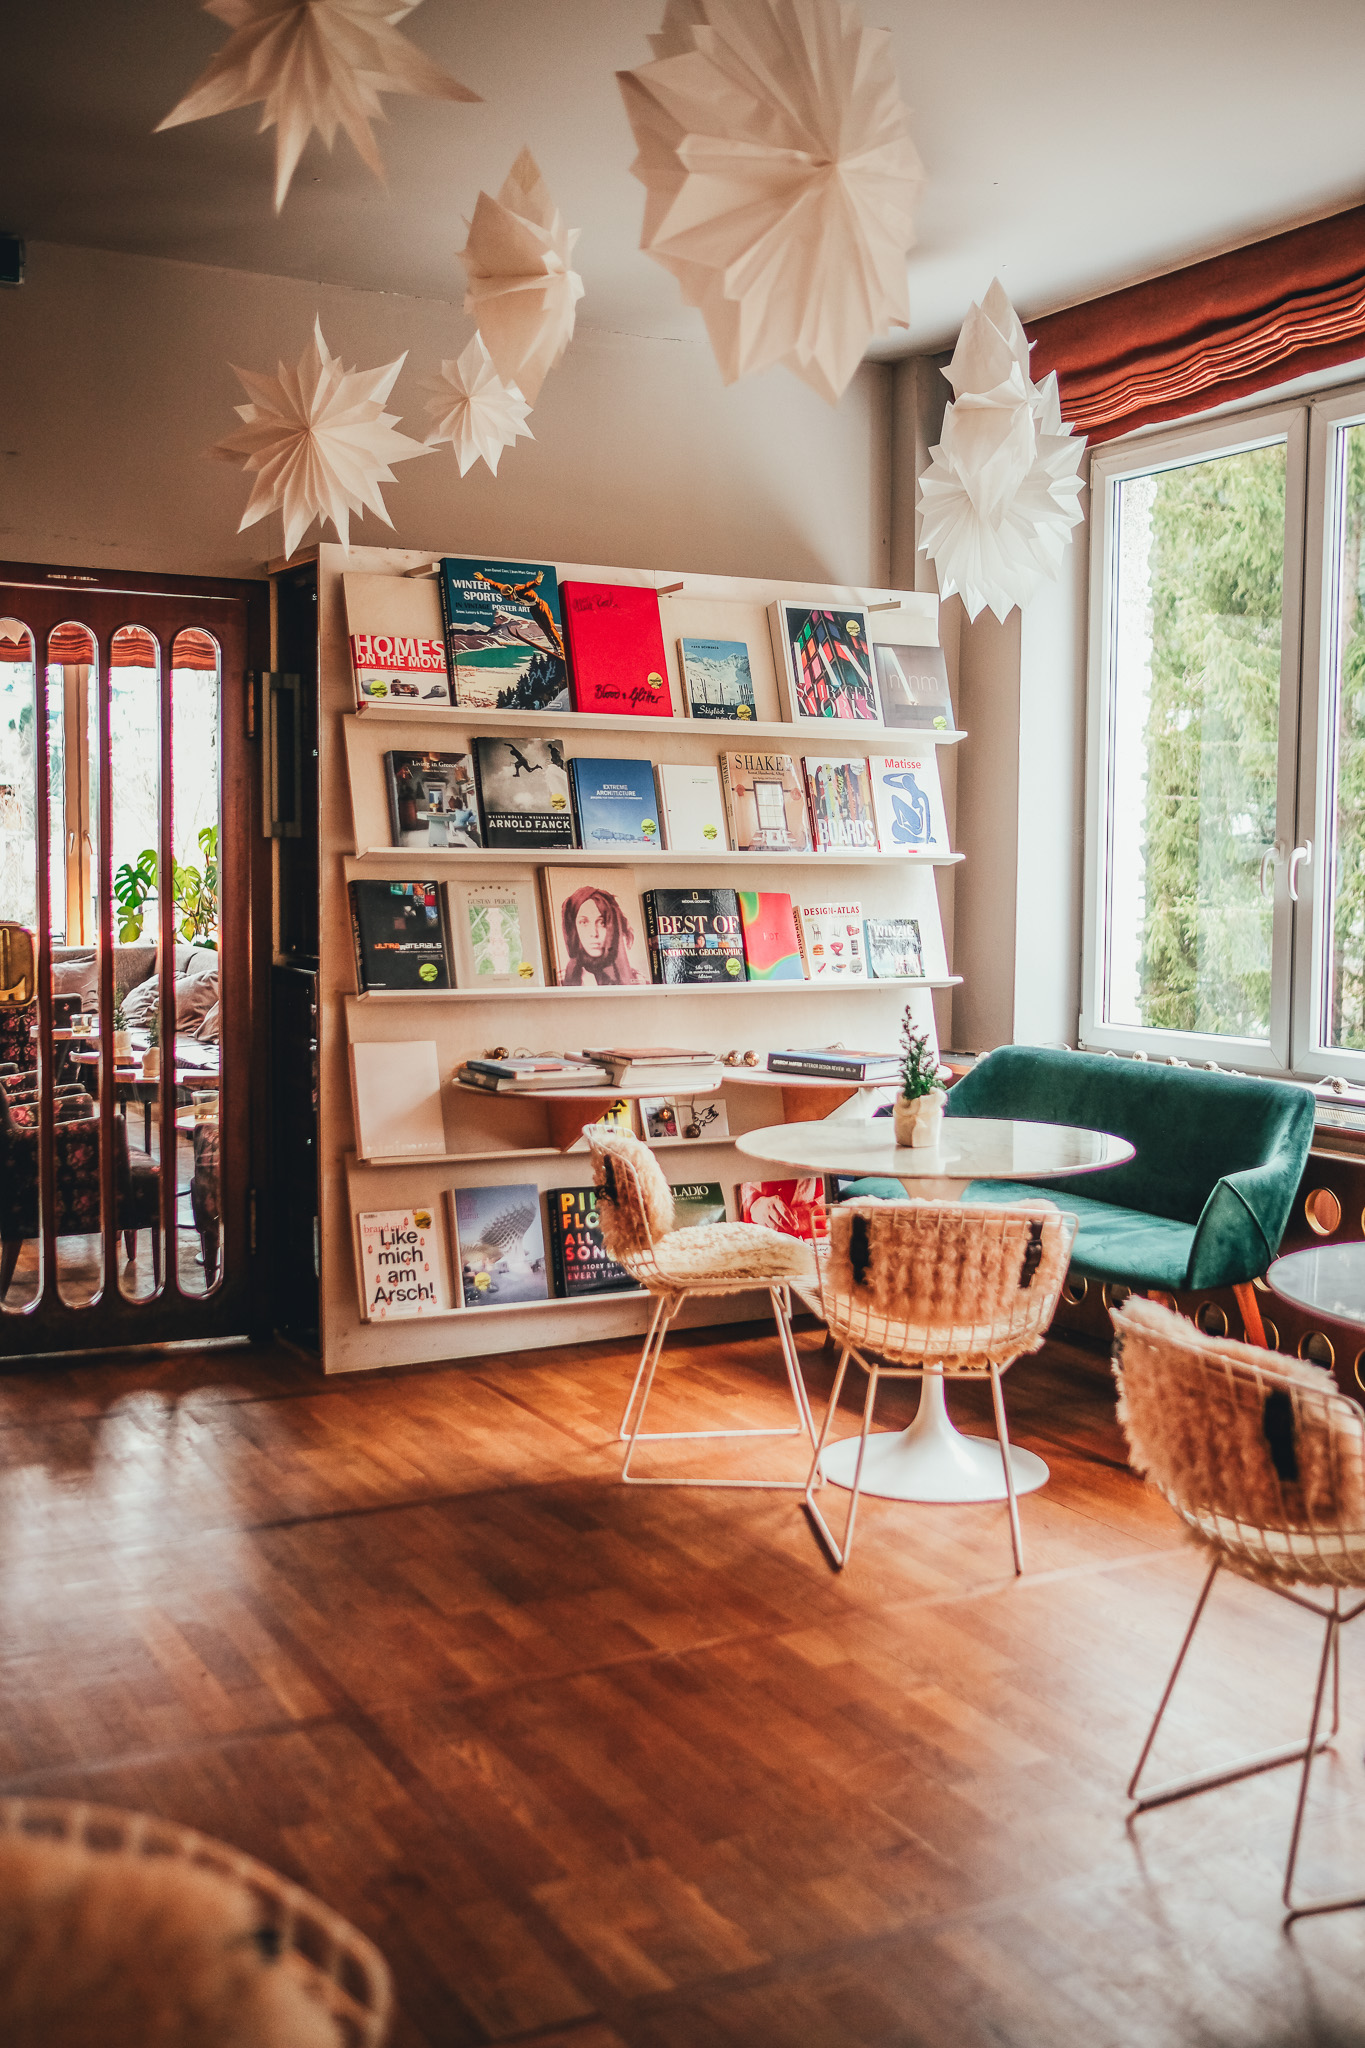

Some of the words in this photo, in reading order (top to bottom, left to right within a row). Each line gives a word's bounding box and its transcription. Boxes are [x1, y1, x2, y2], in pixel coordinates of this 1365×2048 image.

[452, 578, 491, 590] WINTER
[463, 591, 503, 603] SPORTS
[464, 602, 490, 610] VINTAGE
[354, 634, 446, 660] HOMES
[356, 652, 376, 665] ON
[377, 653, 405, 666] THE
[408, 656, 447, 669] MOVE
[796, 682, 875, 702] SCHRAGER
[798, 696, 878, 720] WORKS
[411, 759, 431, 768] Living
[884, 758, 922, 770] Matisse
[489, 820, 532, 828] ARNOLD
[535, 820, 571, 829] FANCK
[817, 818, 875, 845] BOARDS
[803, 905, 860, 916] DESIGN-ATLAS
[658, 915, 708, 934] BEST
[713, 915, 740, 934] OF
[662, 949, 698, 957] NATIONAL
[698, 948, 743, 956] GEOGRAPHIC
[672, 1185, 709, 1197] LADIO
[363, 1222, 390, 1234] brand
[380, 1228, 419, 1246] Like
[564, 1231, 594, 1246] ALL
[378, 1246, 423, 1265] mich
[387, 1269, 417, 1283] am
[567, 1271, 598, 1280] EVERY
[374, 1282, 434, 1304] Arsch!
